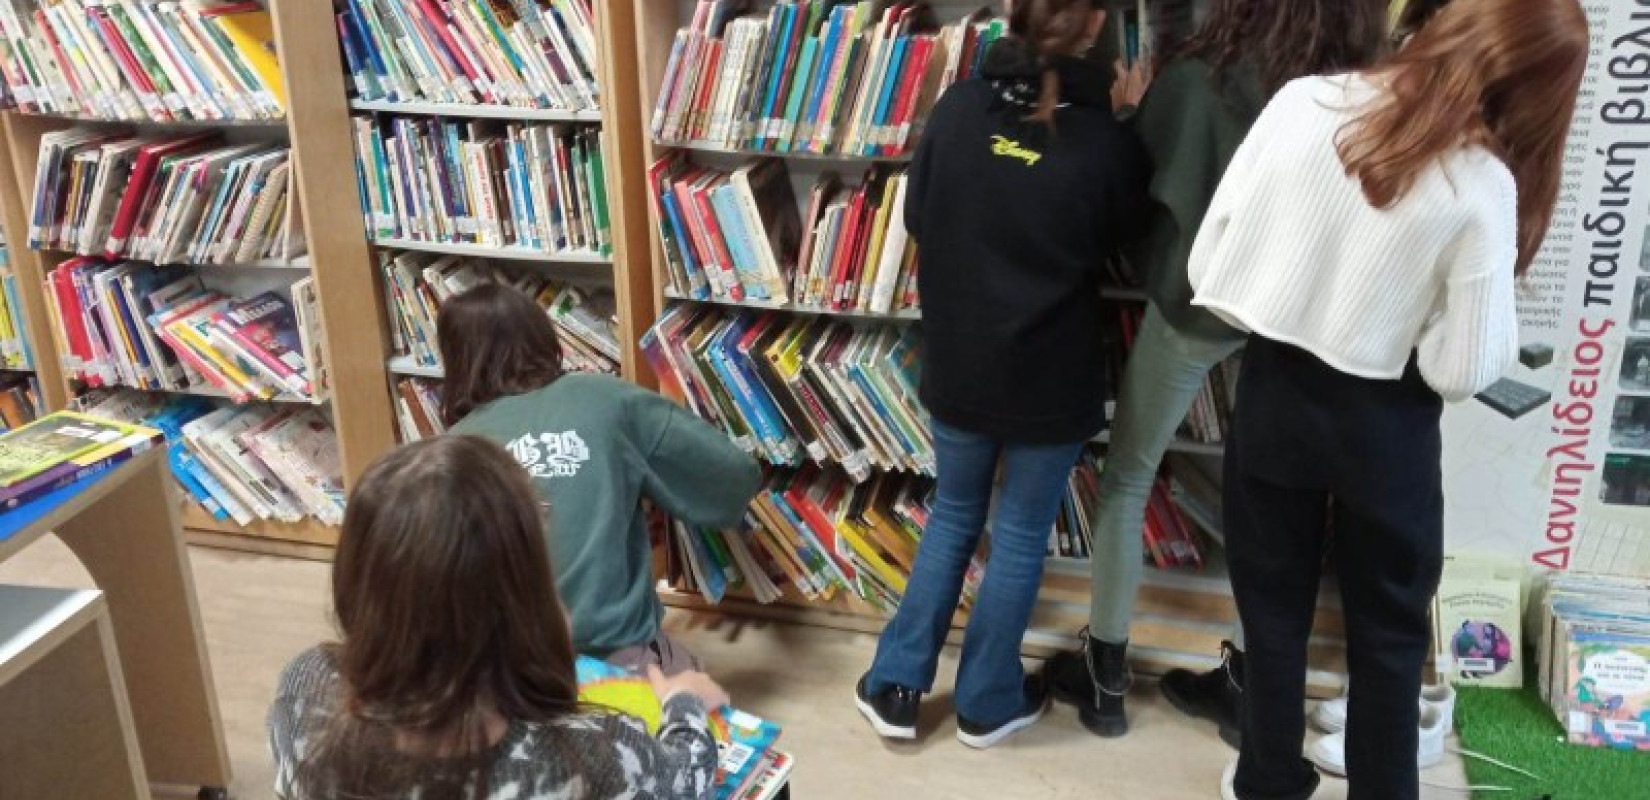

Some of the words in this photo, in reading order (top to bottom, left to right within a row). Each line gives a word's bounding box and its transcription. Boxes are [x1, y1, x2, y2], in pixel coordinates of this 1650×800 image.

[1600, 0, 1650, 124] βιβλι
[1583, 142, 1650, 308] παιδική
[1532, 318, 1616, 571] Δανιηλίδειος
